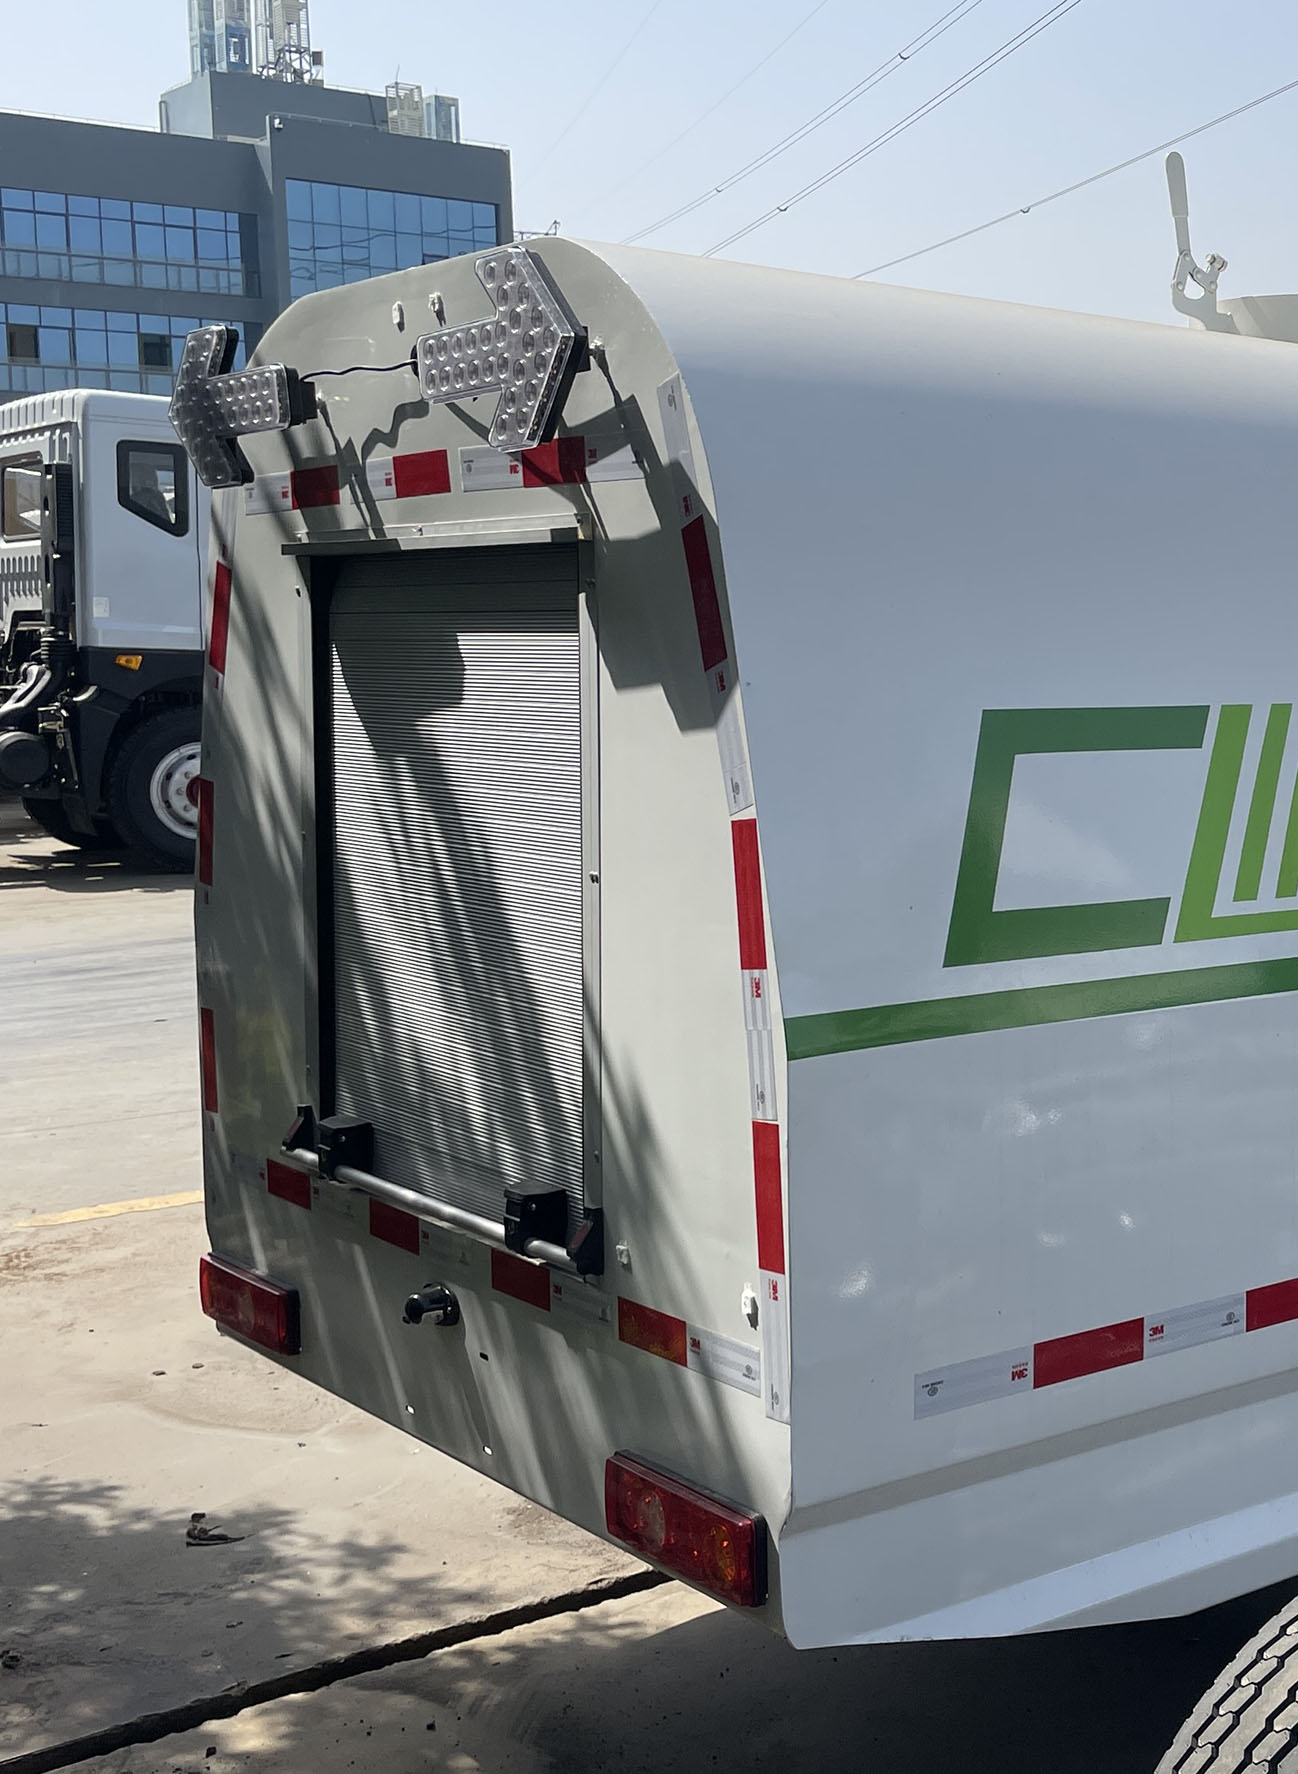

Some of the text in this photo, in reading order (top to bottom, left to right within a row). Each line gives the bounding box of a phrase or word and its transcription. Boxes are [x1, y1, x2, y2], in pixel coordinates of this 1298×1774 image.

[771, 1279, 778, 1301] 3M
[1148, 1325, 1164, 1338] 3M
[1011, 1368, 1028, 1381] 3M
